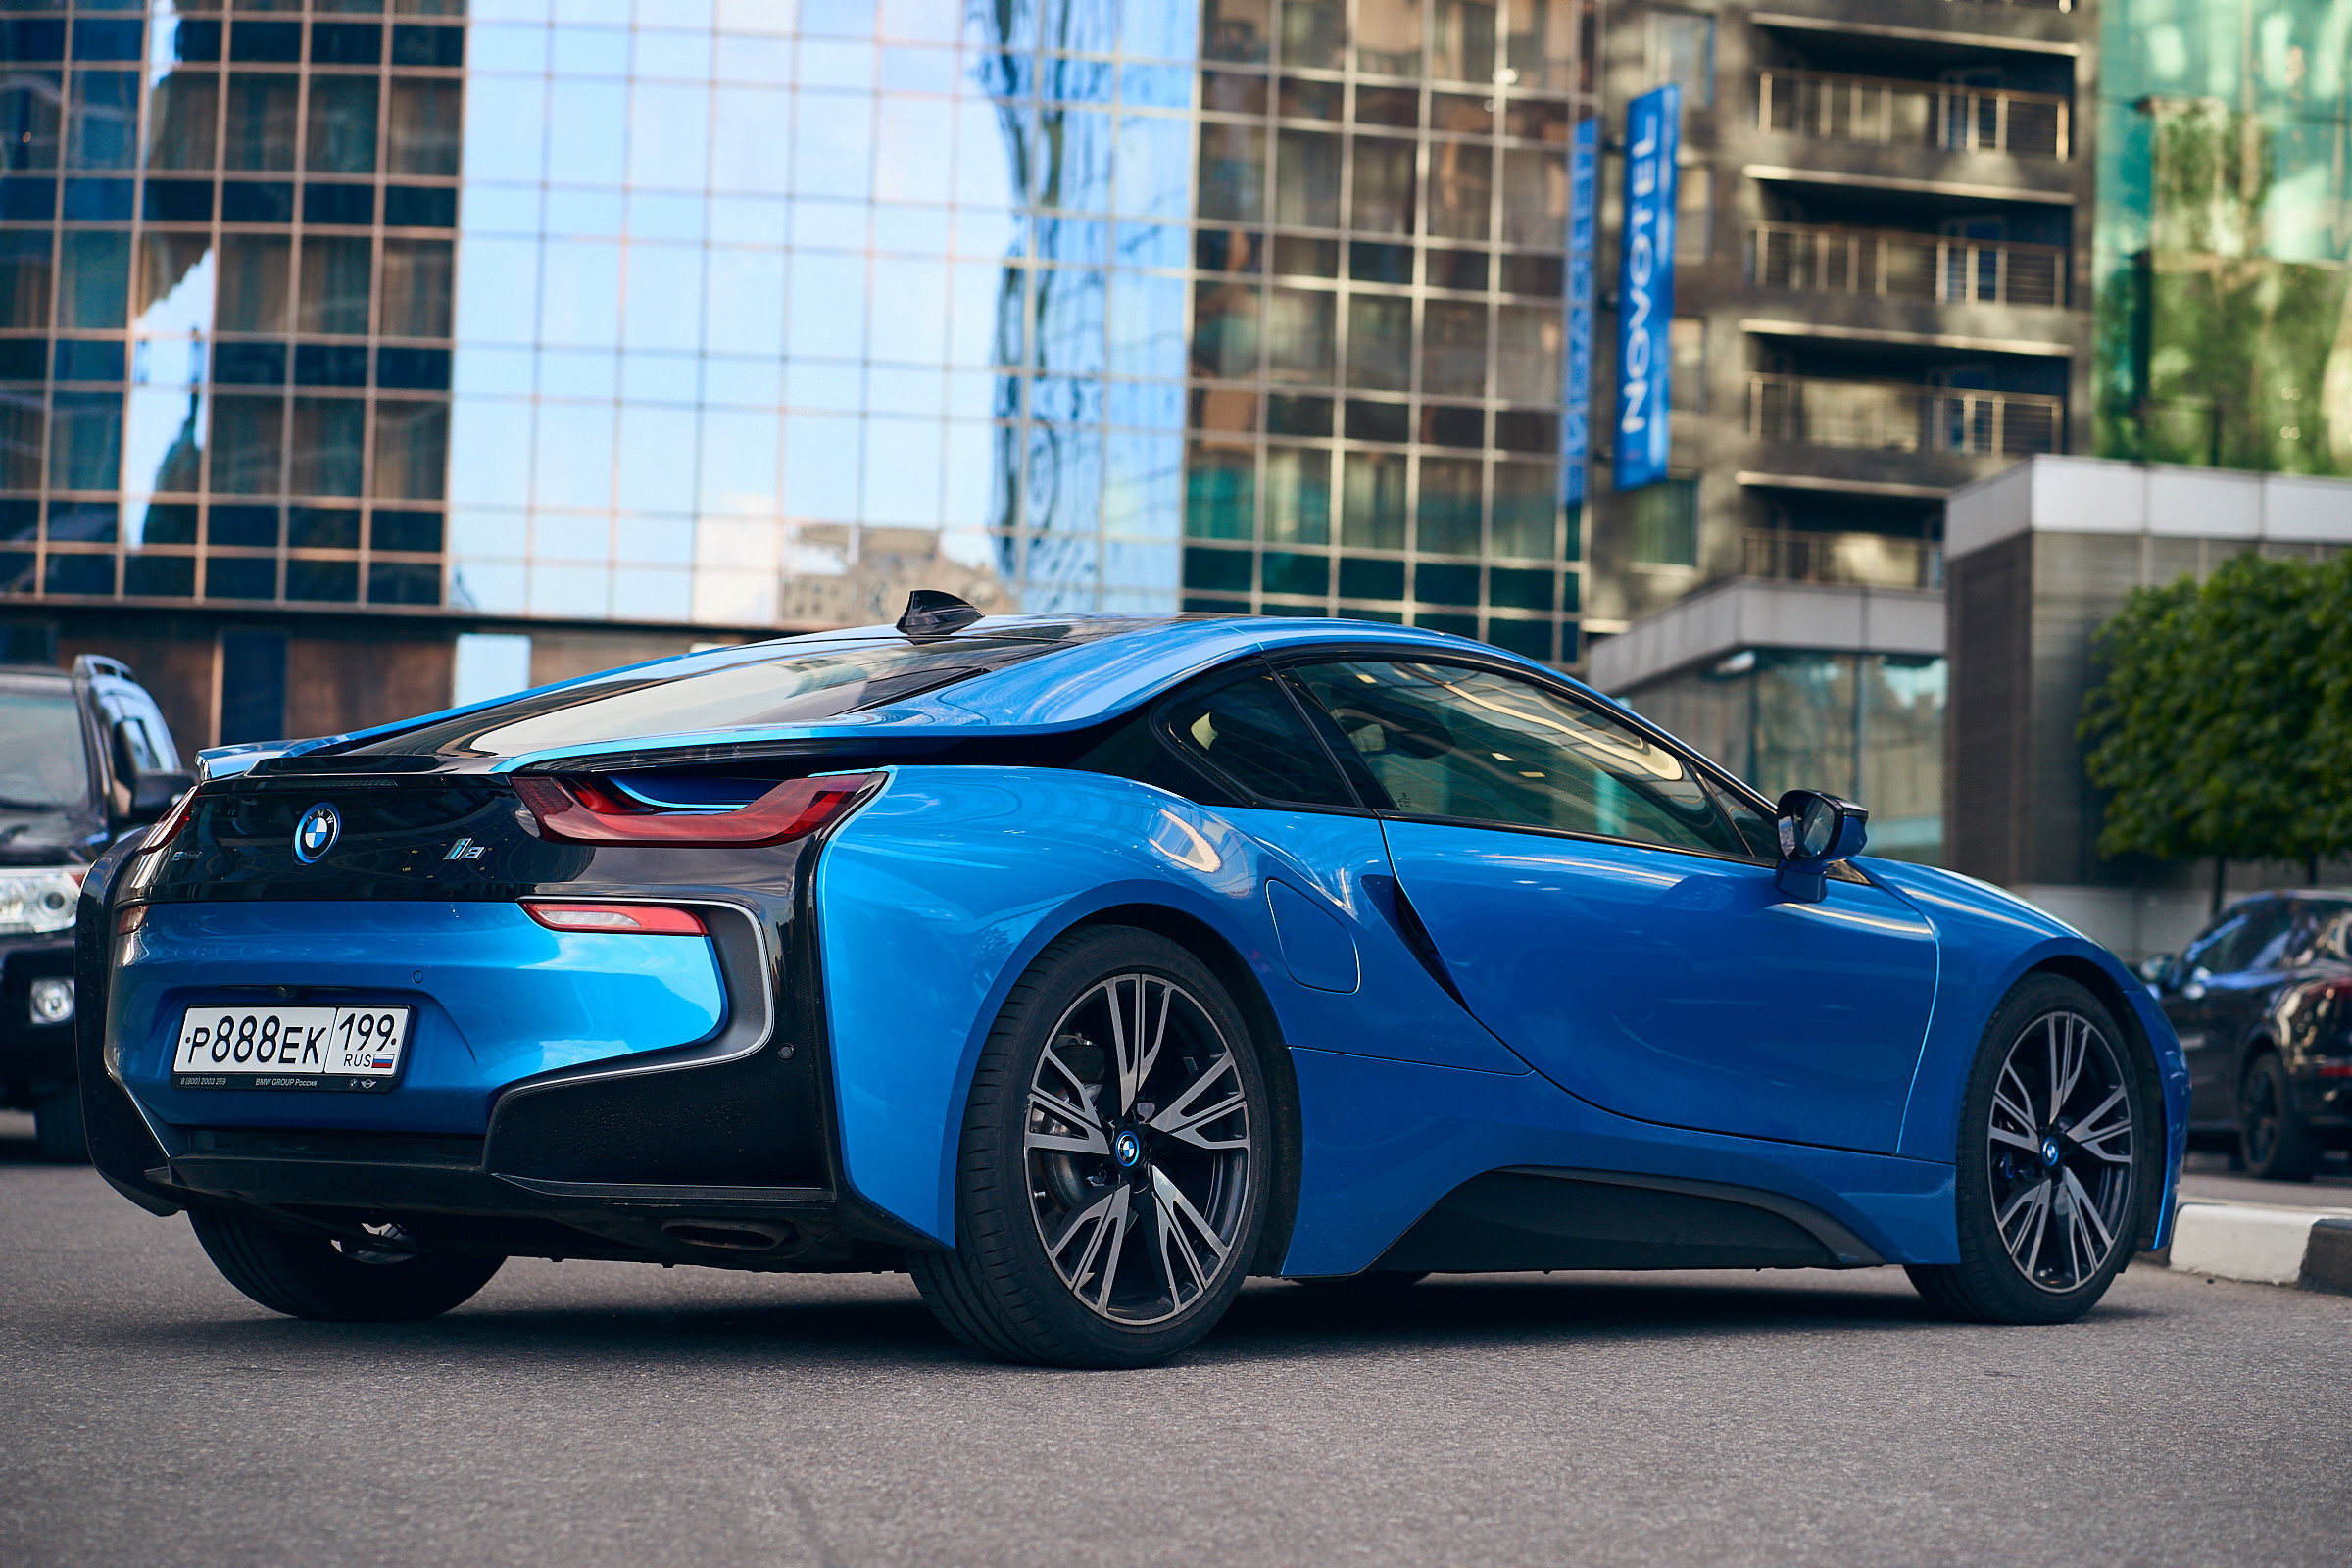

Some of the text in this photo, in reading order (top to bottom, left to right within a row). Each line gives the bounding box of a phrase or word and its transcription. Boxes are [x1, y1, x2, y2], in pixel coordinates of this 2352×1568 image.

[1621, 114, 1658, 434] NOVOTEL
[339, 1013, 395, 1052] 199
[343, 1054, 372, 1067] RUS
